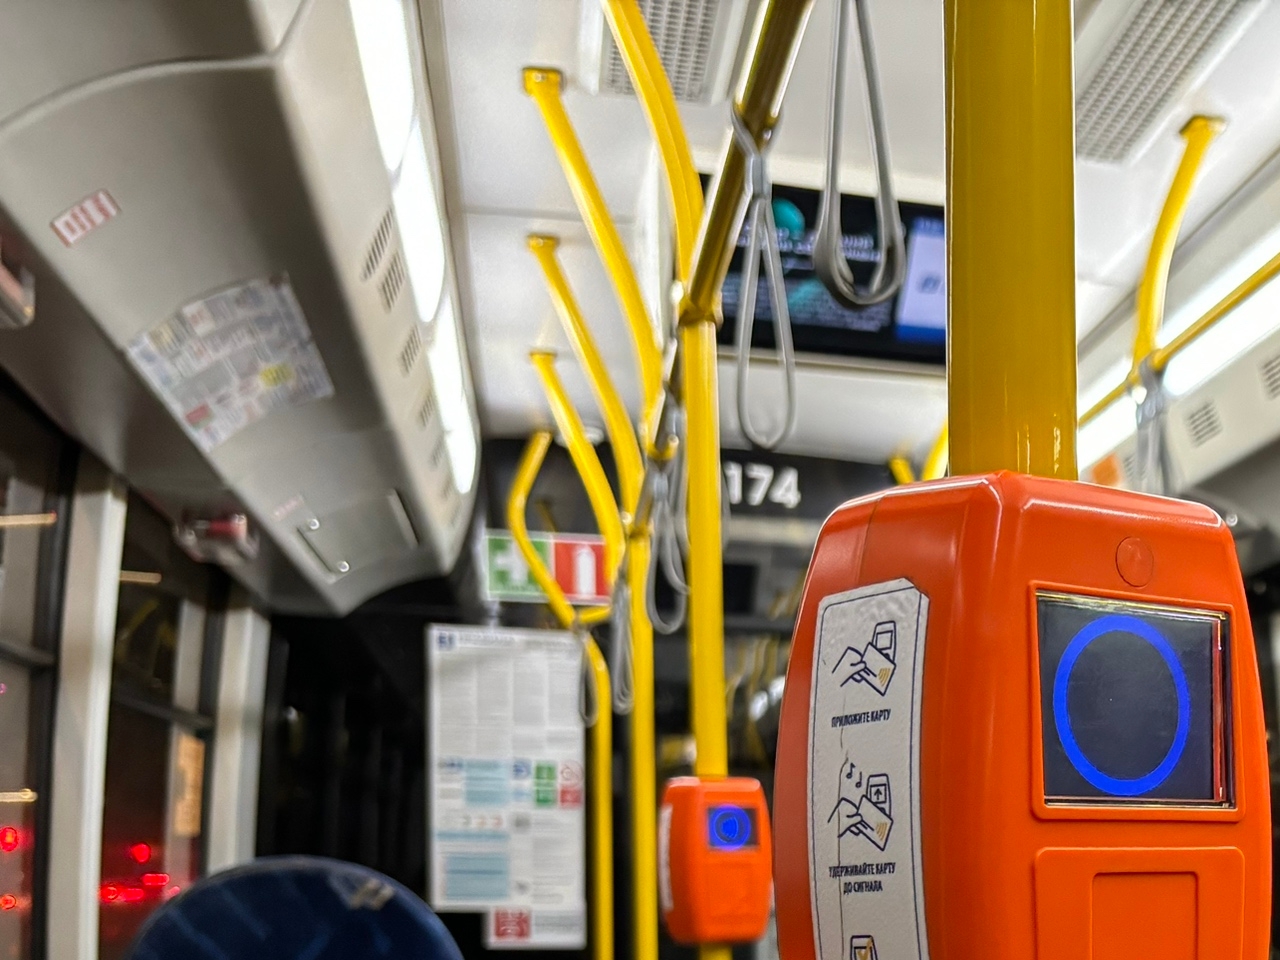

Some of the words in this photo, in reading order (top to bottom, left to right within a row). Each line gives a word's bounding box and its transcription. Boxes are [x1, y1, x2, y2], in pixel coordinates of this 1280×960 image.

[724, 461, 801, 509] 174
[832, 711, 870, 727] ПРИЛОЖИТЕ
[871, 709, 891, 721] КАРТУ
[829, 862, 875, 878] УДЕРЖИВАЙТЕ
[875, 862, 896, 875] КАРТУ
[843, 881, 852, 895] ДО
[853, 880, 883, 893] СИГНАЛА
